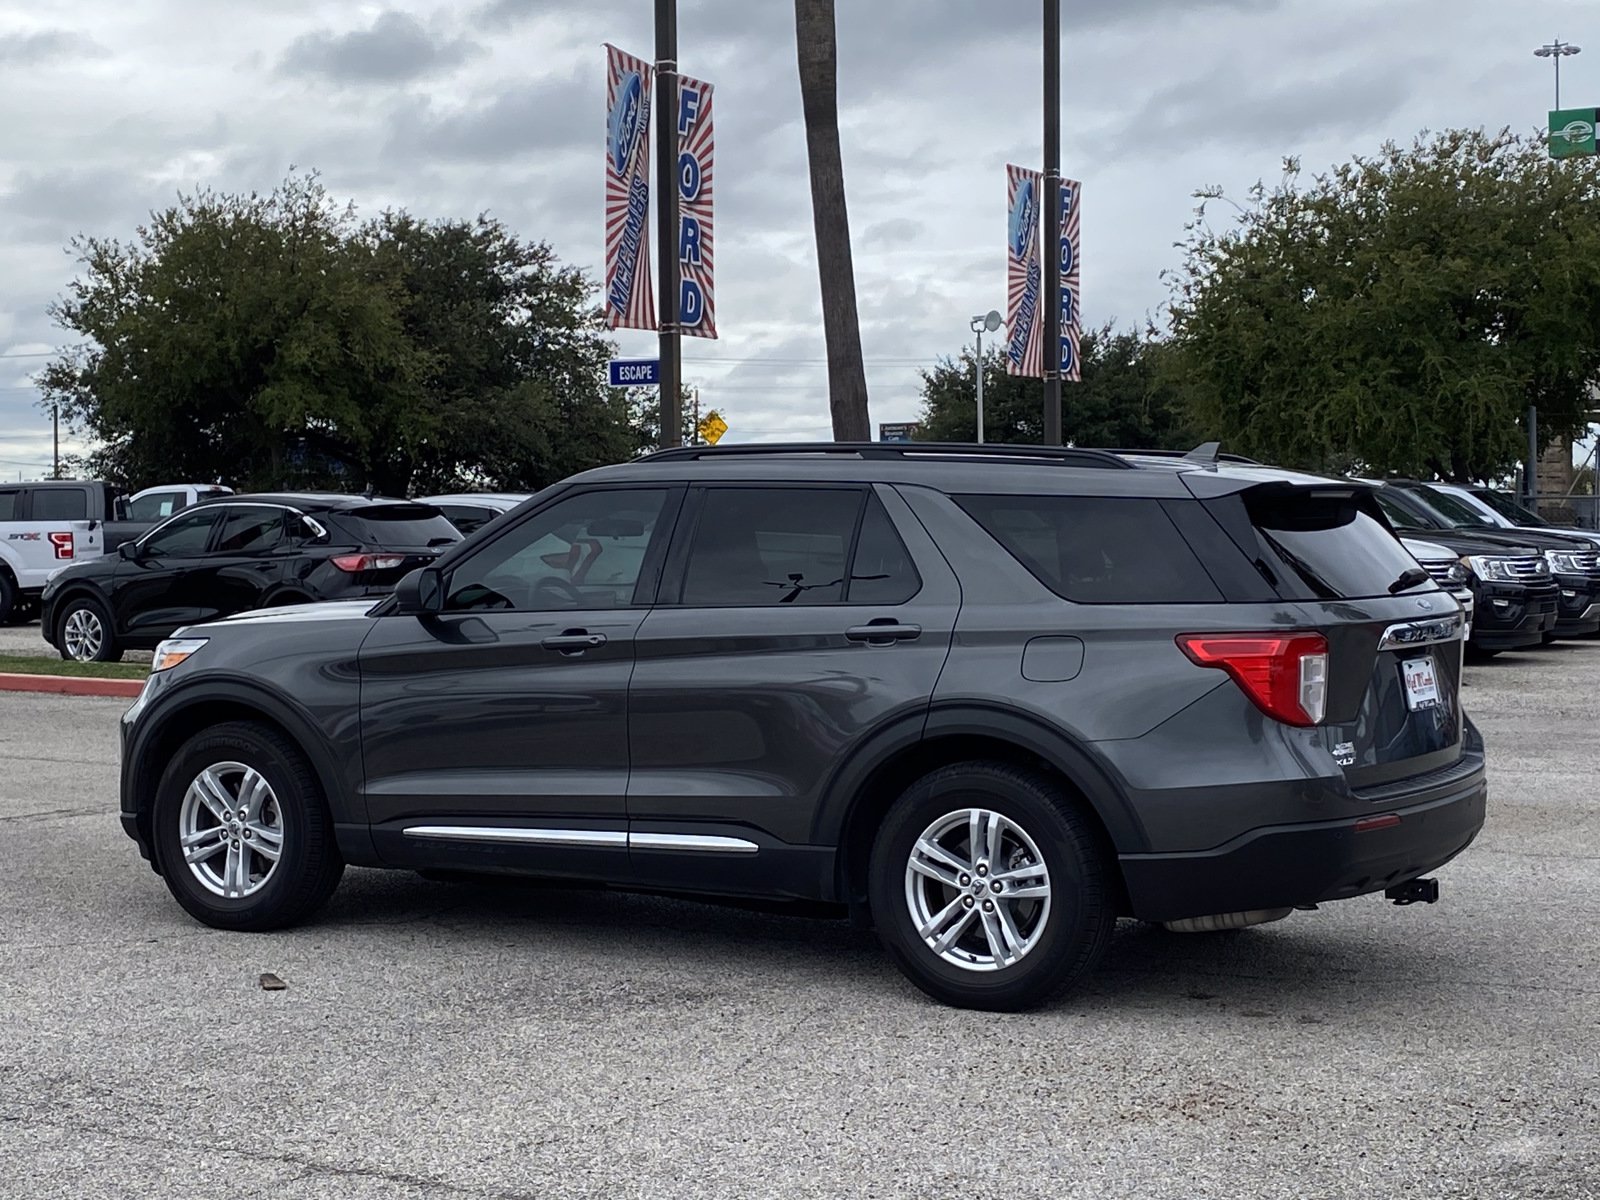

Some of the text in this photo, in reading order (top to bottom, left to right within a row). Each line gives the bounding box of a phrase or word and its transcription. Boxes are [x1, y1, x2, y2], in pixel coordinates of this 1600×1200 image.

[618, 90, 637, 158] Ford
[678, 88, 703, 326] FORD
[1060, 186, 1074, 373] FORD
[619, 365, 653, 381] ESCAPE
[1335, 757, 1356, 767] XLT
